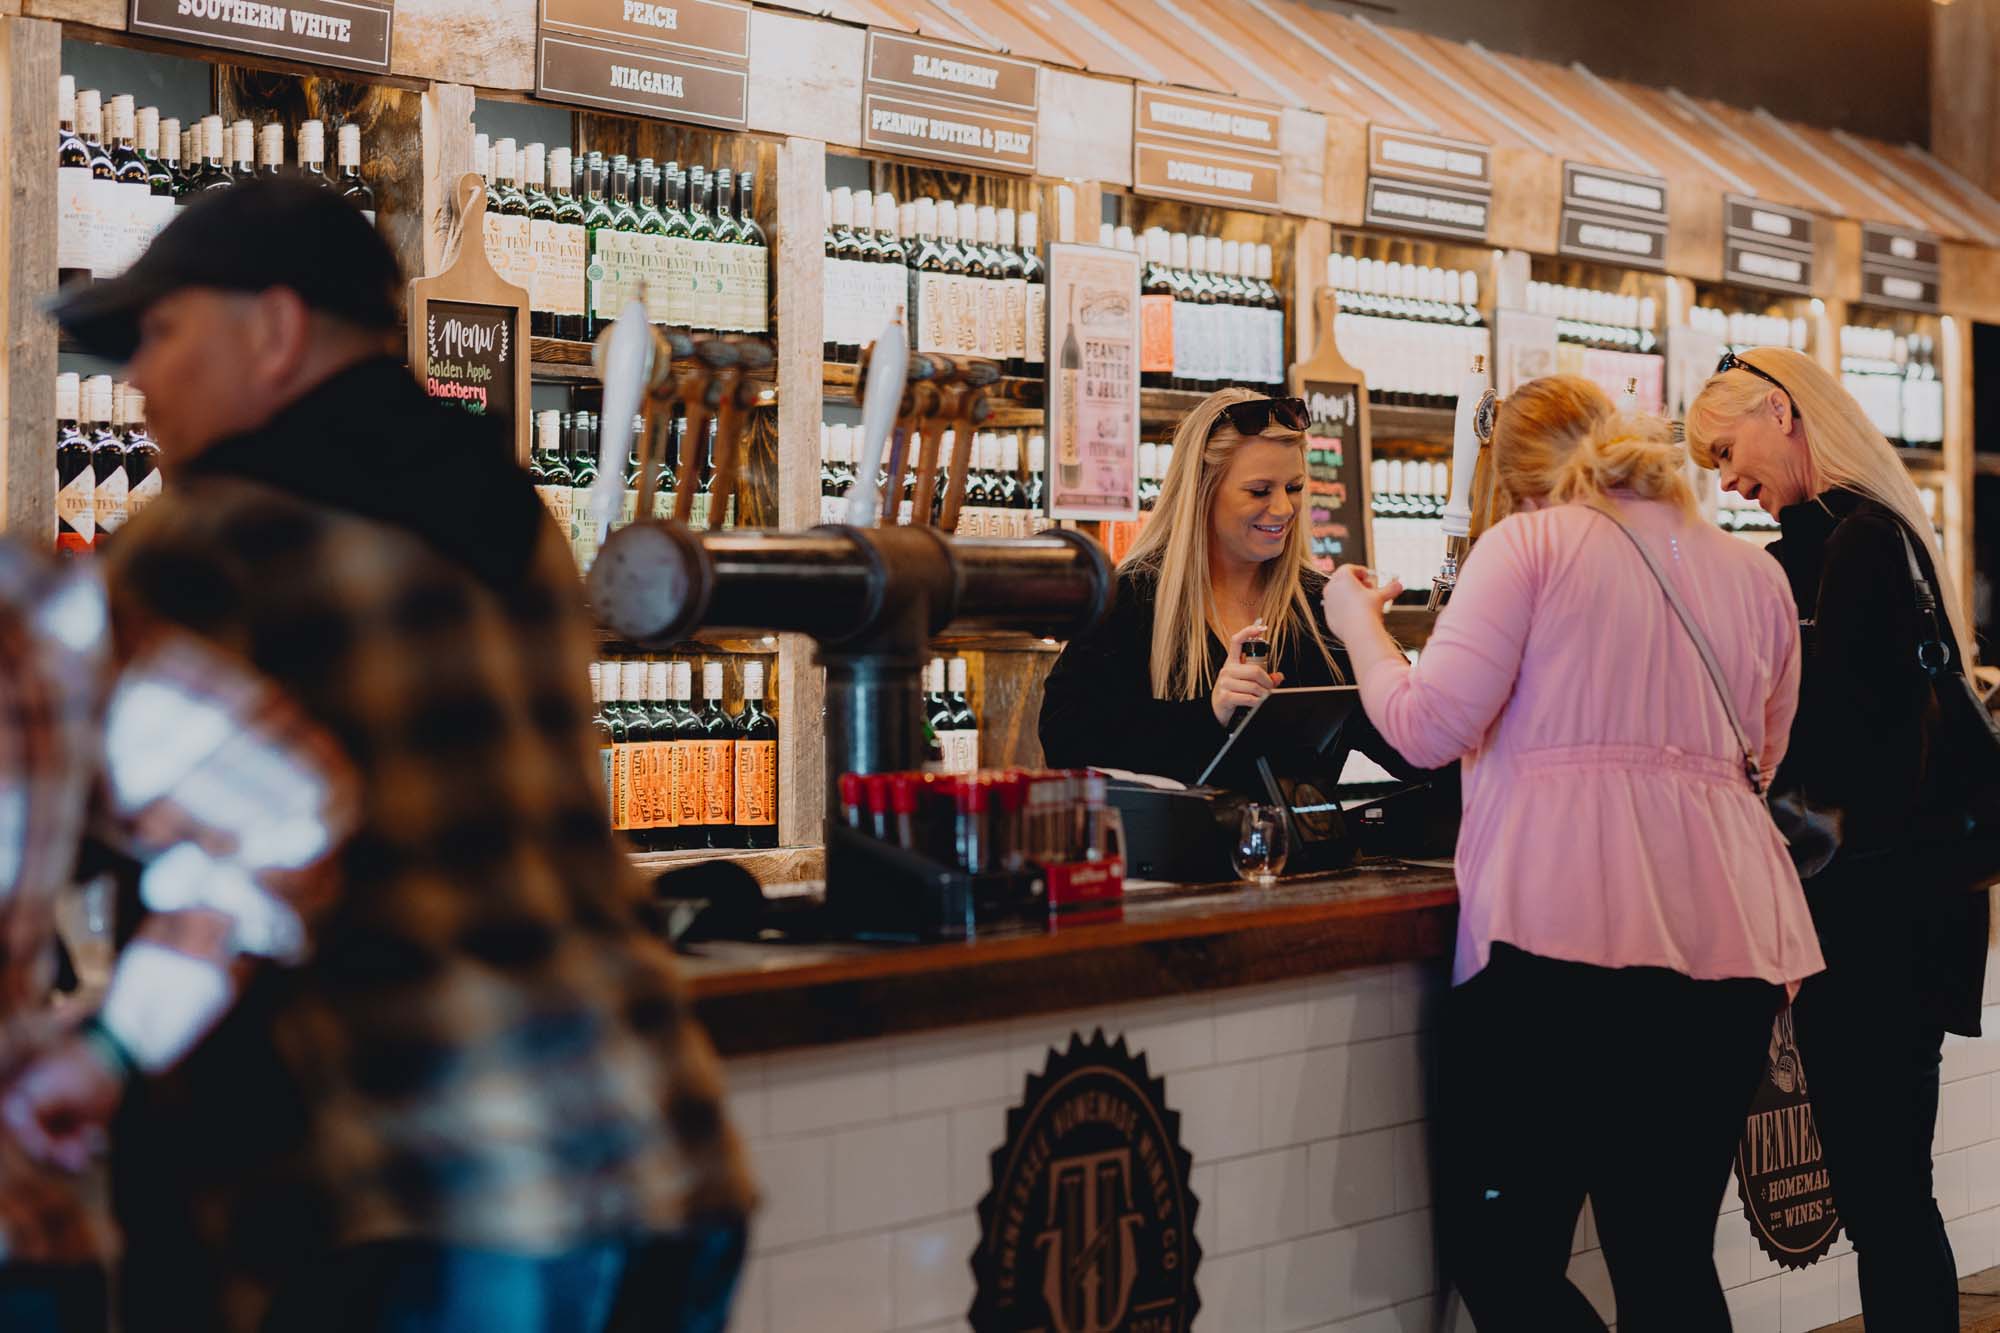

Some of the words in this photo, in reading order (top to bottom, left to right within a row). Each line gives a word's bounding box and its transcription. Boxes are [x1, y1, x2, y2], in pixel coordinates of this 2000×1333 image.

[178, 0, 287, 31] SOUTHERN
[290, 10, 352, 43] WHITE
[623, 0, 678, 29] PEACH
[610, 65, 684, 98] NIAGARA
[912, 54, 999, 89] BLACKBERRY
[872, 109, 929, 138] PEANUT
[929, 119, 981, 147] BUTTER
[982, 127, 994, 149] &
[994, 129, 1031, 154] JELLY
[438, 318, 500, 358] Menu
[1085, 341, 1131, 362] PEANUT
[427, 356, 463, 379] Golden
[466, 361, 492, 383] Apple
[427, 377, 487, 409] Blackberry
[1784, 1199, 1823, 1230] WINES
